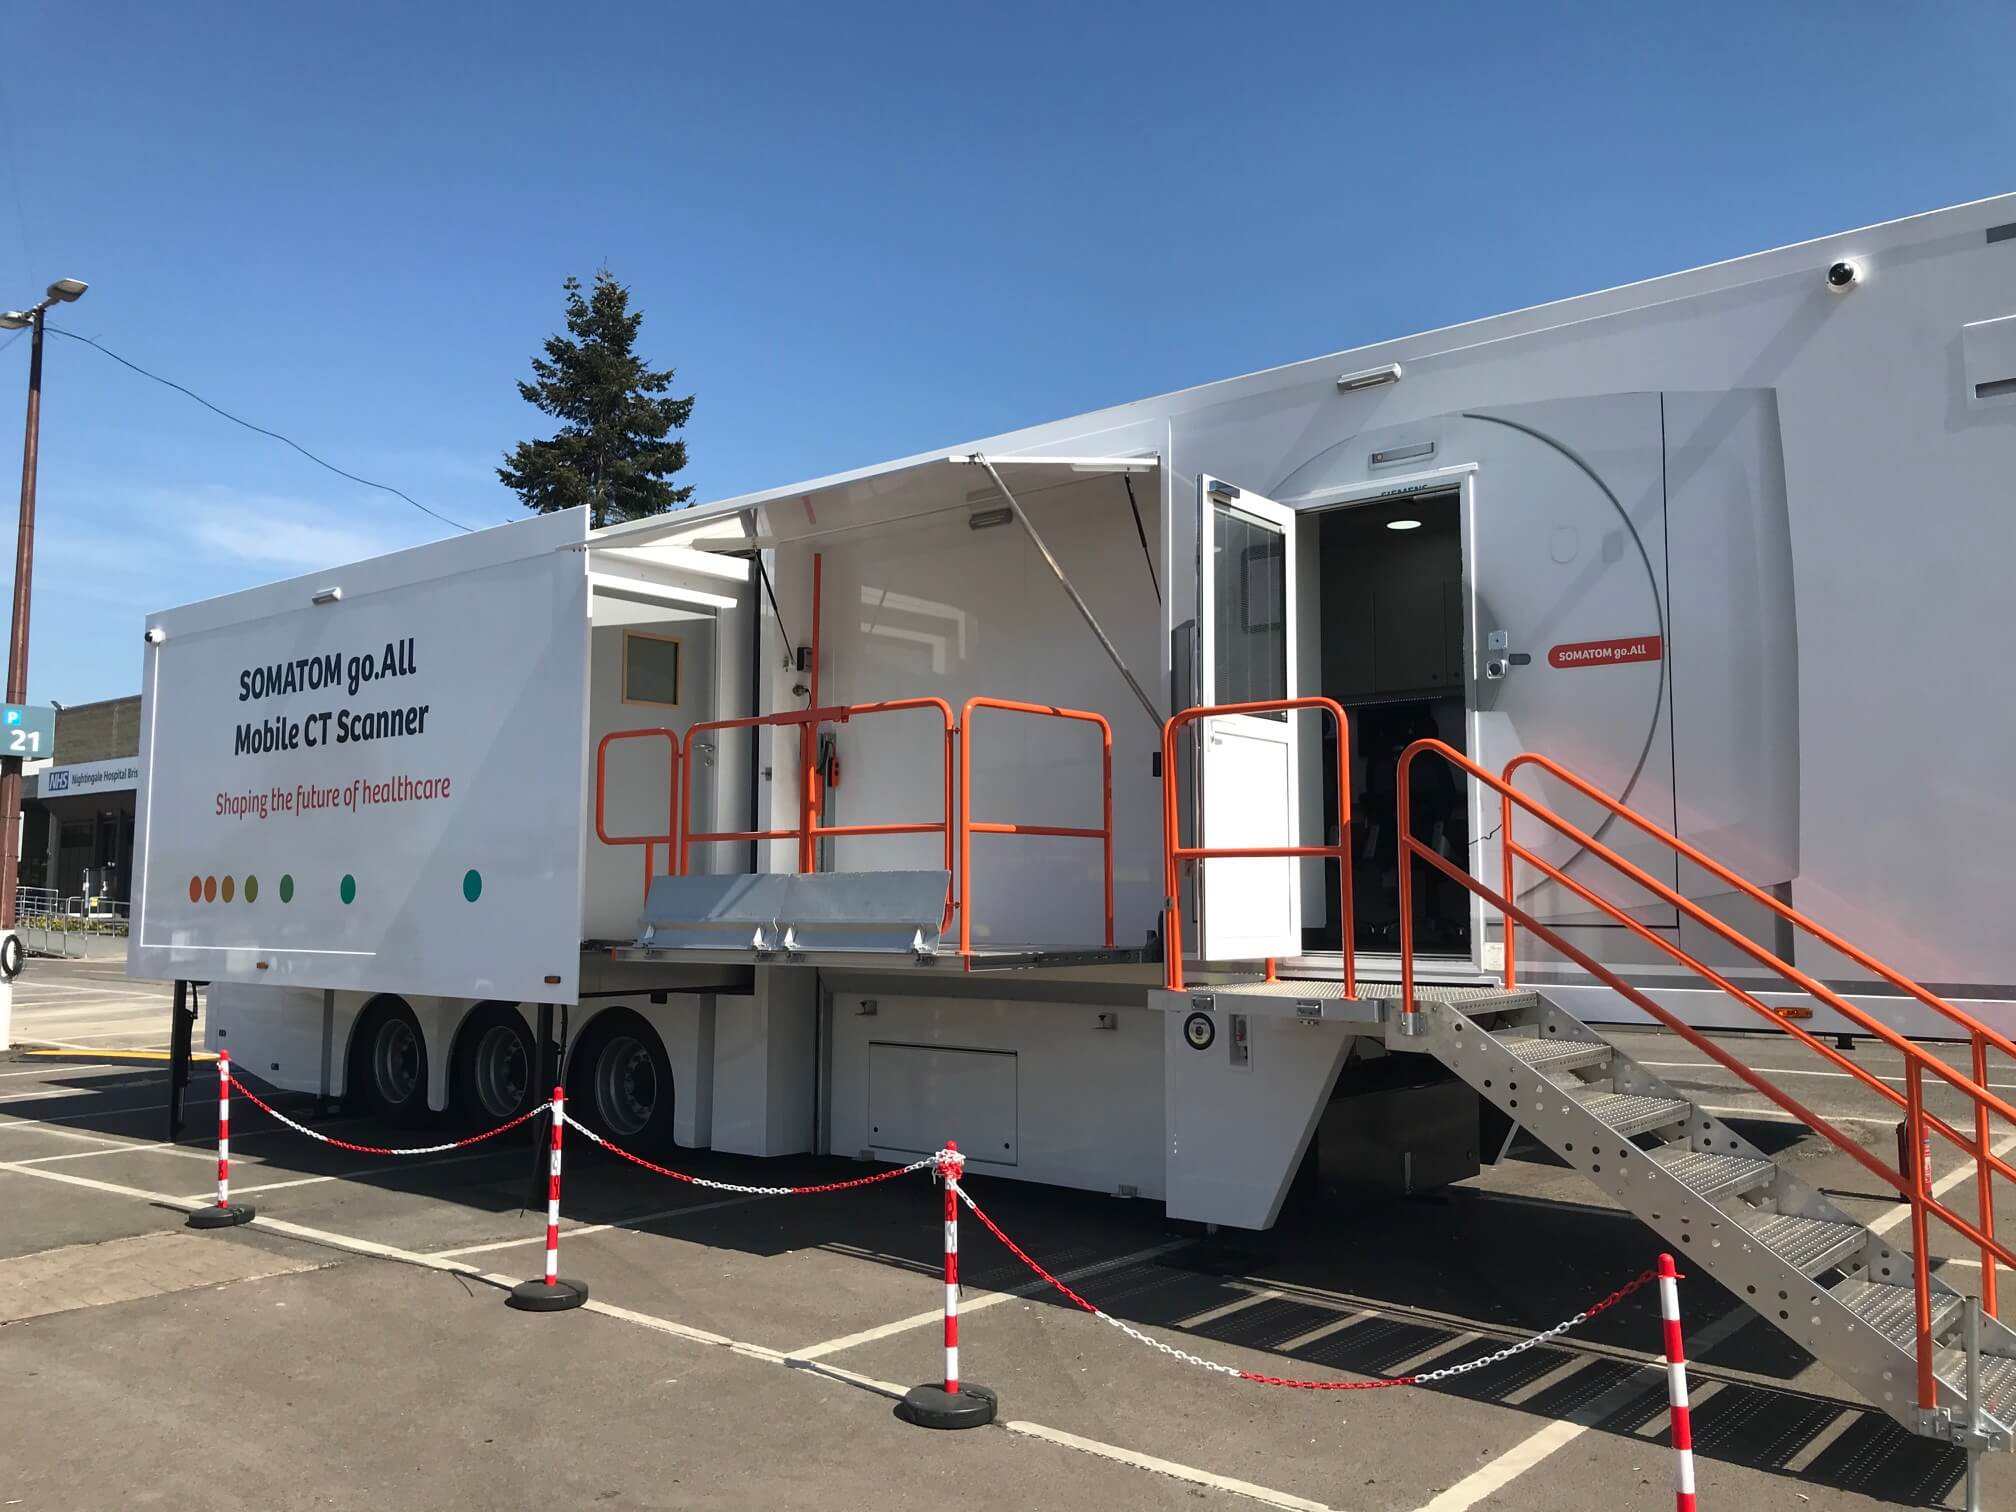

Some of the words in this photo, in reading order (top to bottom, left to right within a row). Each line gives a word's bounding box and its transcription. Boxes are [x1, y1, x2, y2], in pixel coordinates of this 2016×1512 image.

[1559, 648, 1612, 661] SOMATOM
[1614, 644, 1647, 659] go.All
[239, 653, 342, 701] SOMATOM
[347, 638, 417, 696] go.All
[8, 711, 19, 724] P
[10, 729, 40, 752] 21
[234, 716, 299, 756] Mobile
[304, 712, 332, 747] CT
[336, 705, 430, 744] Scanner
[49, 772, 68, 790] NHS
[72, 771, 102, 787] Nightingale
[103, 768, 127, 782] Hospital
[215, 789, 268, 820] Shaping
[271, 787, 293, 812] the
[296, 784, 340, 816] future
[343, 780, 360, 813] of
[362, 775, 451, 805] healthcare
